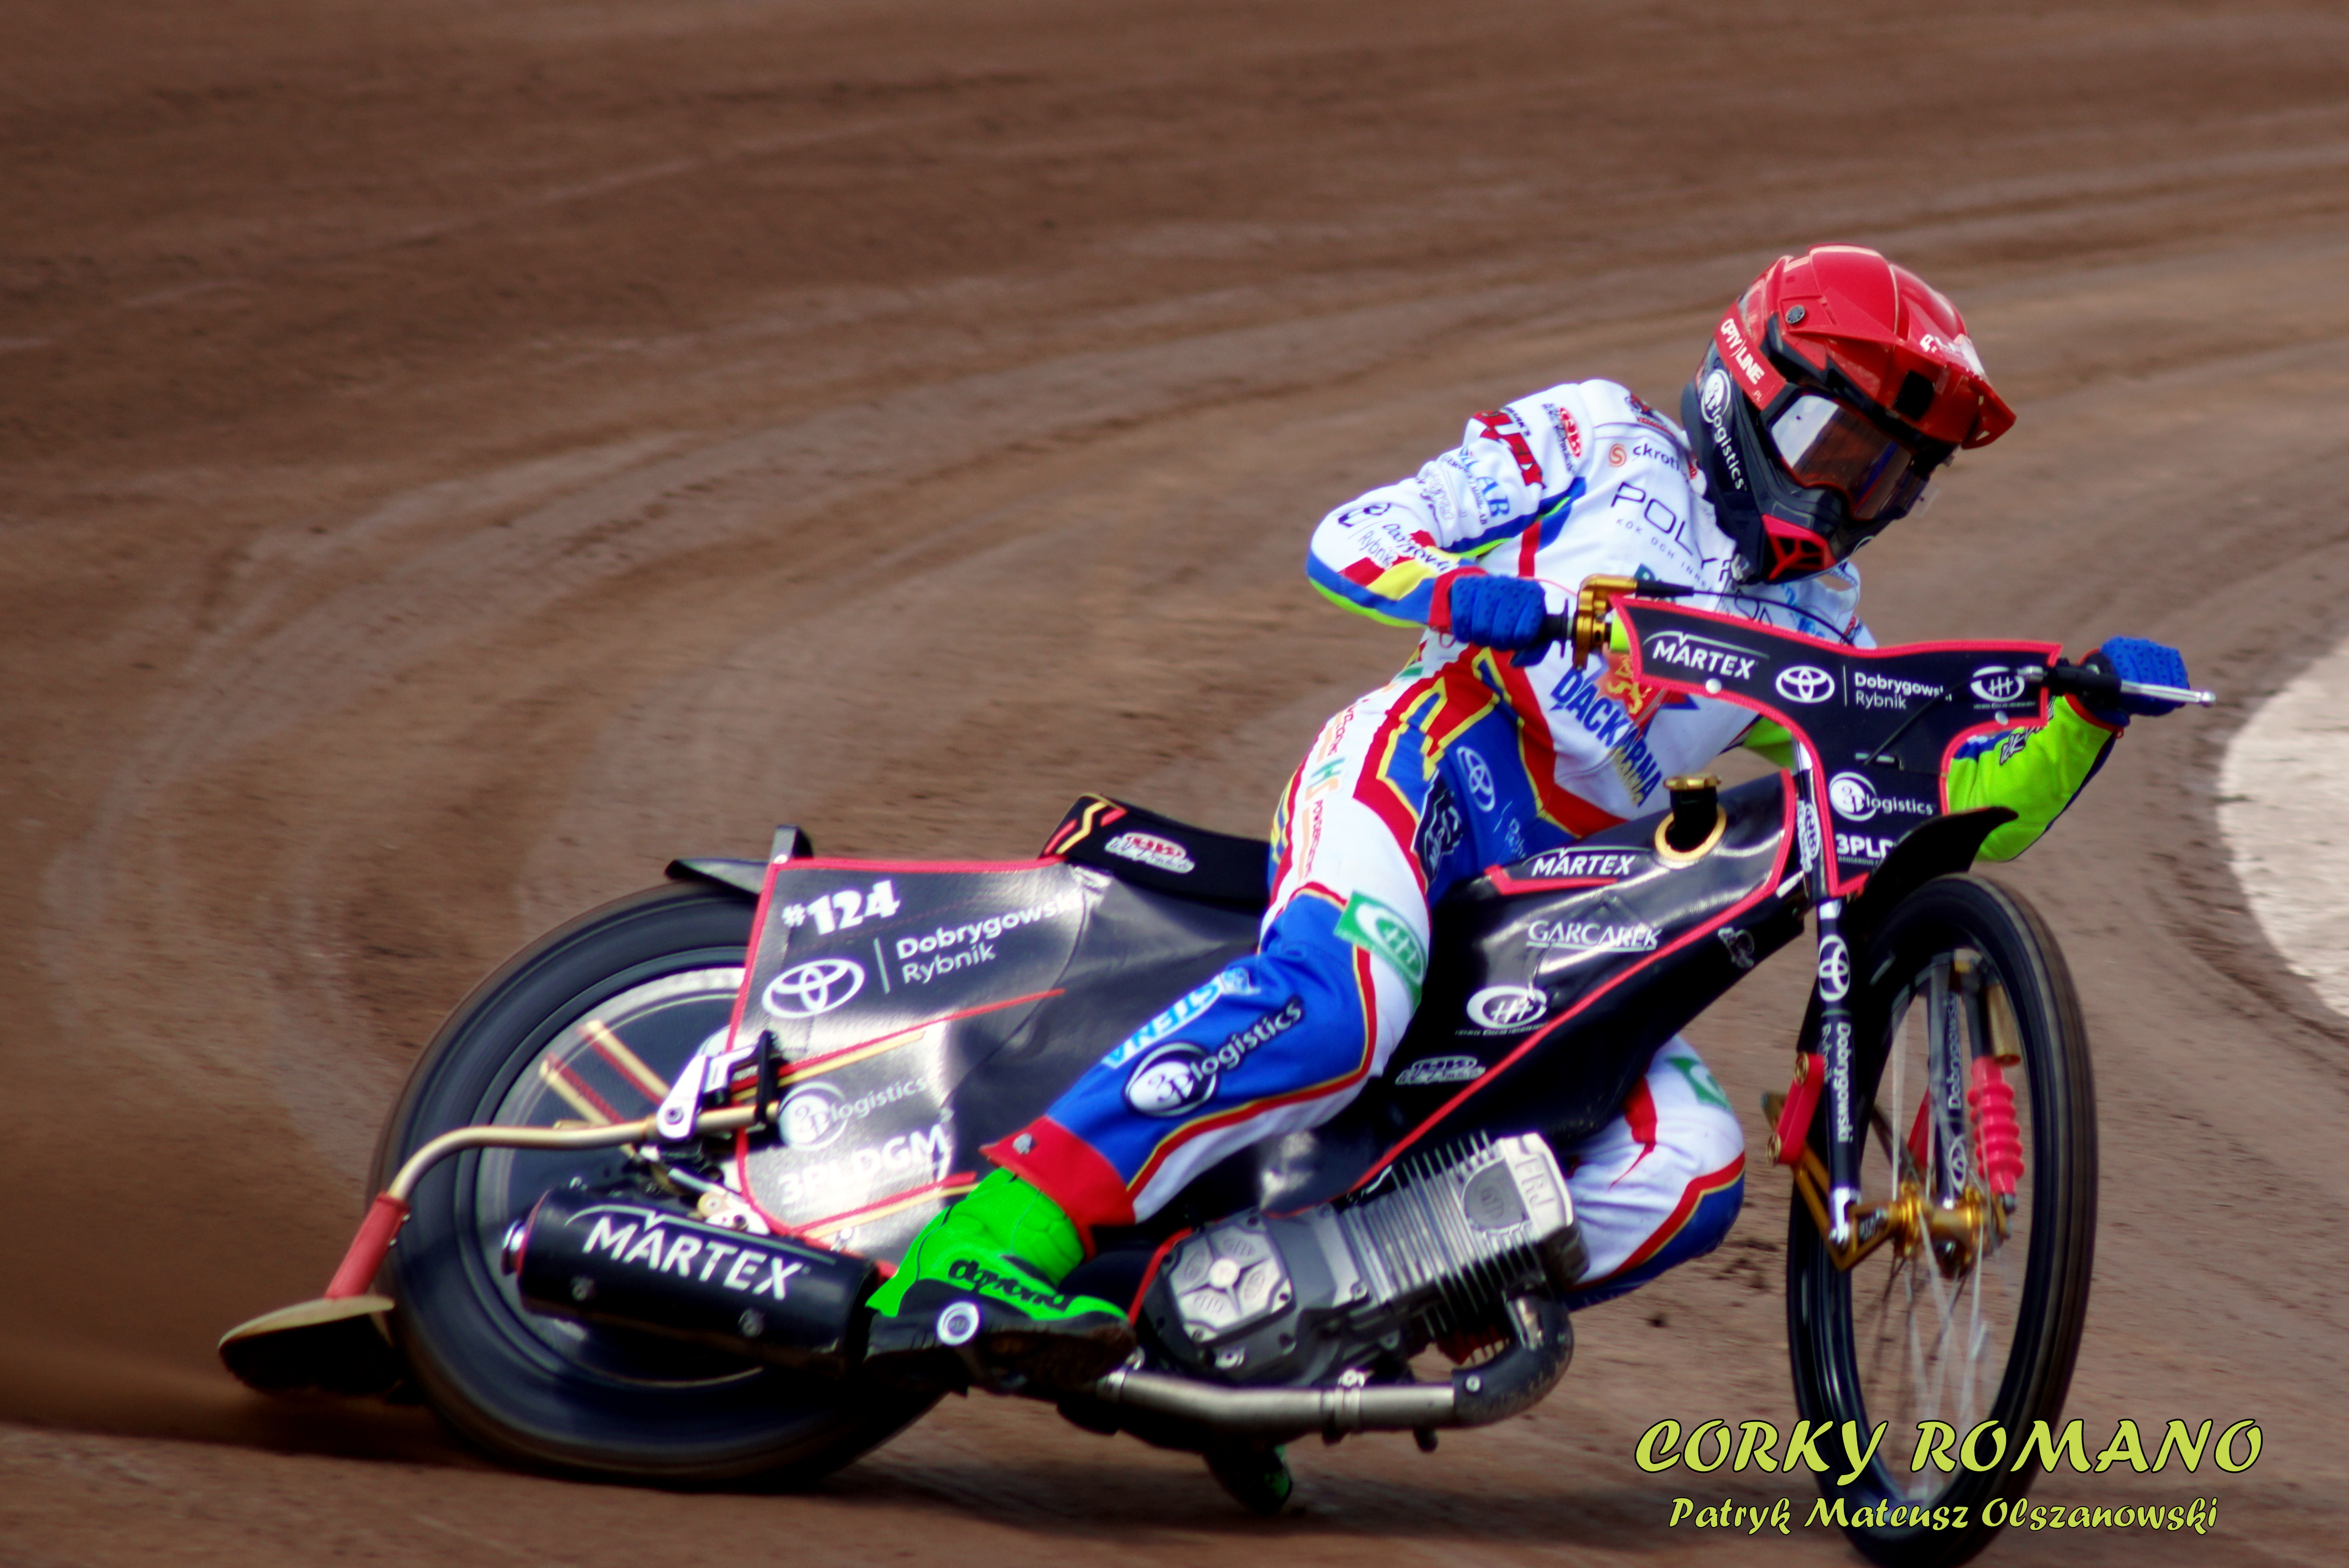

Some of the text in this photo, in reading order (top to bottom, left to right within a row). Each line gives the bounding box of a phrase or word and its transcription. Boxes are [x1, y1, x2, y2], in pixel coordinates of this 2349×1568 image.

[1735, 346, 1765, 385] LINE
[1712, 406, 1744, 490] logistics
[1652, 640, 1755, 680] MARTEX
[1856, 690, 1906, 710] Rybnik
[1866, 793, 1933, 816] logistics
[1531, 855, 1636, 876] MARTEX
[782, 880, 901, 936] #124
[896, 887, 1088, 960] Dobrygowski
[1527, 920, 1662, 948] GARCAREK
[902, 942, 996, 985] Rybnik
[1189, 999, 1302, 1081] logistics
[829, 1077, 927, 1123] logistics
[778, 1124, 949, 1206] 3PLDGM
[582, 1214, 802, 1300] MARTEX
[947, 1258, 1073, 1316] daytona
